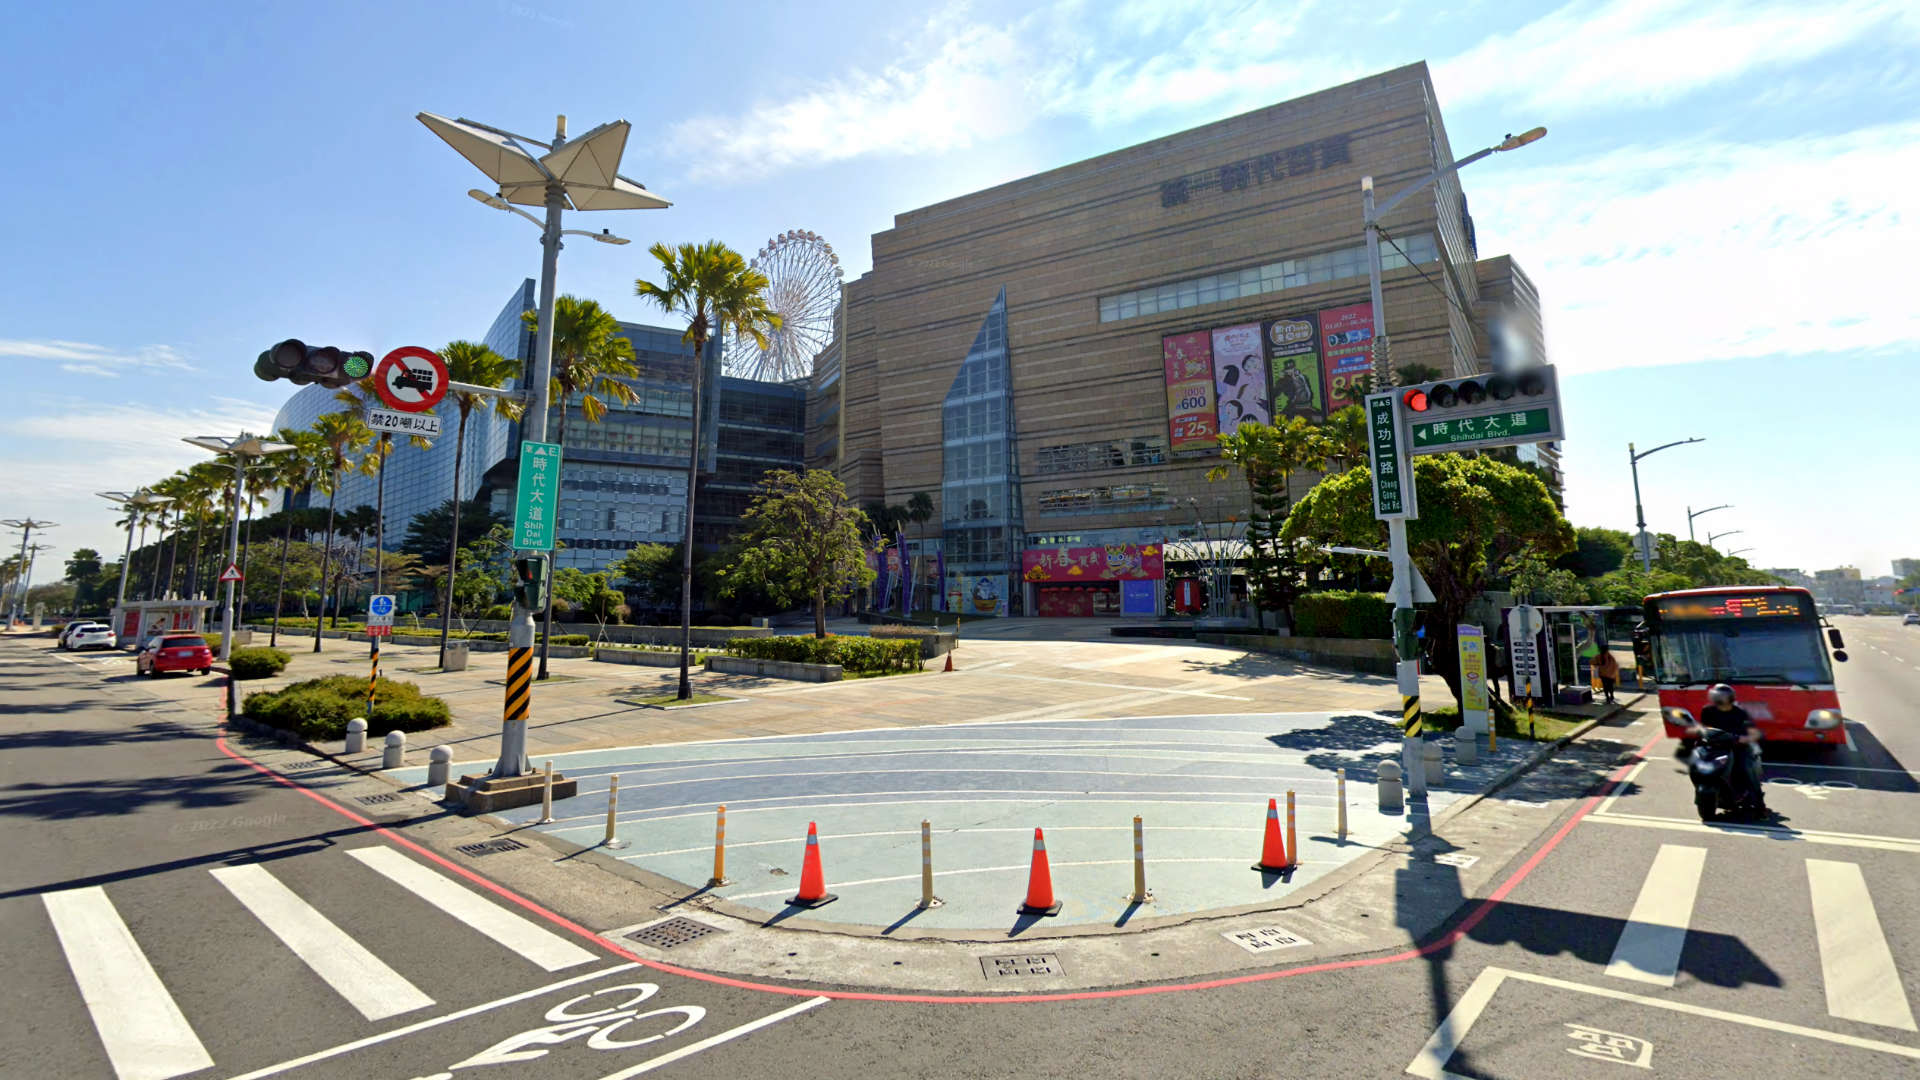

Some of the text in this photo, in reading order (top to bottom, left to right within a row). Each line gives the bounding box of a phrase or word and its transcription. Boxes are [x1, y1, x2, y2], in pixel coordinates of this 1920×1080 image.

[1182, 396, 1206, 409] 600
[1433, 413, 1527, 435] 時代大道
[1377, 411, 1394, 474] 成功二路
[1450, 429, 1511, 442] Shihdai Blvd.
[528, 456, 548, 521] 時代大道
